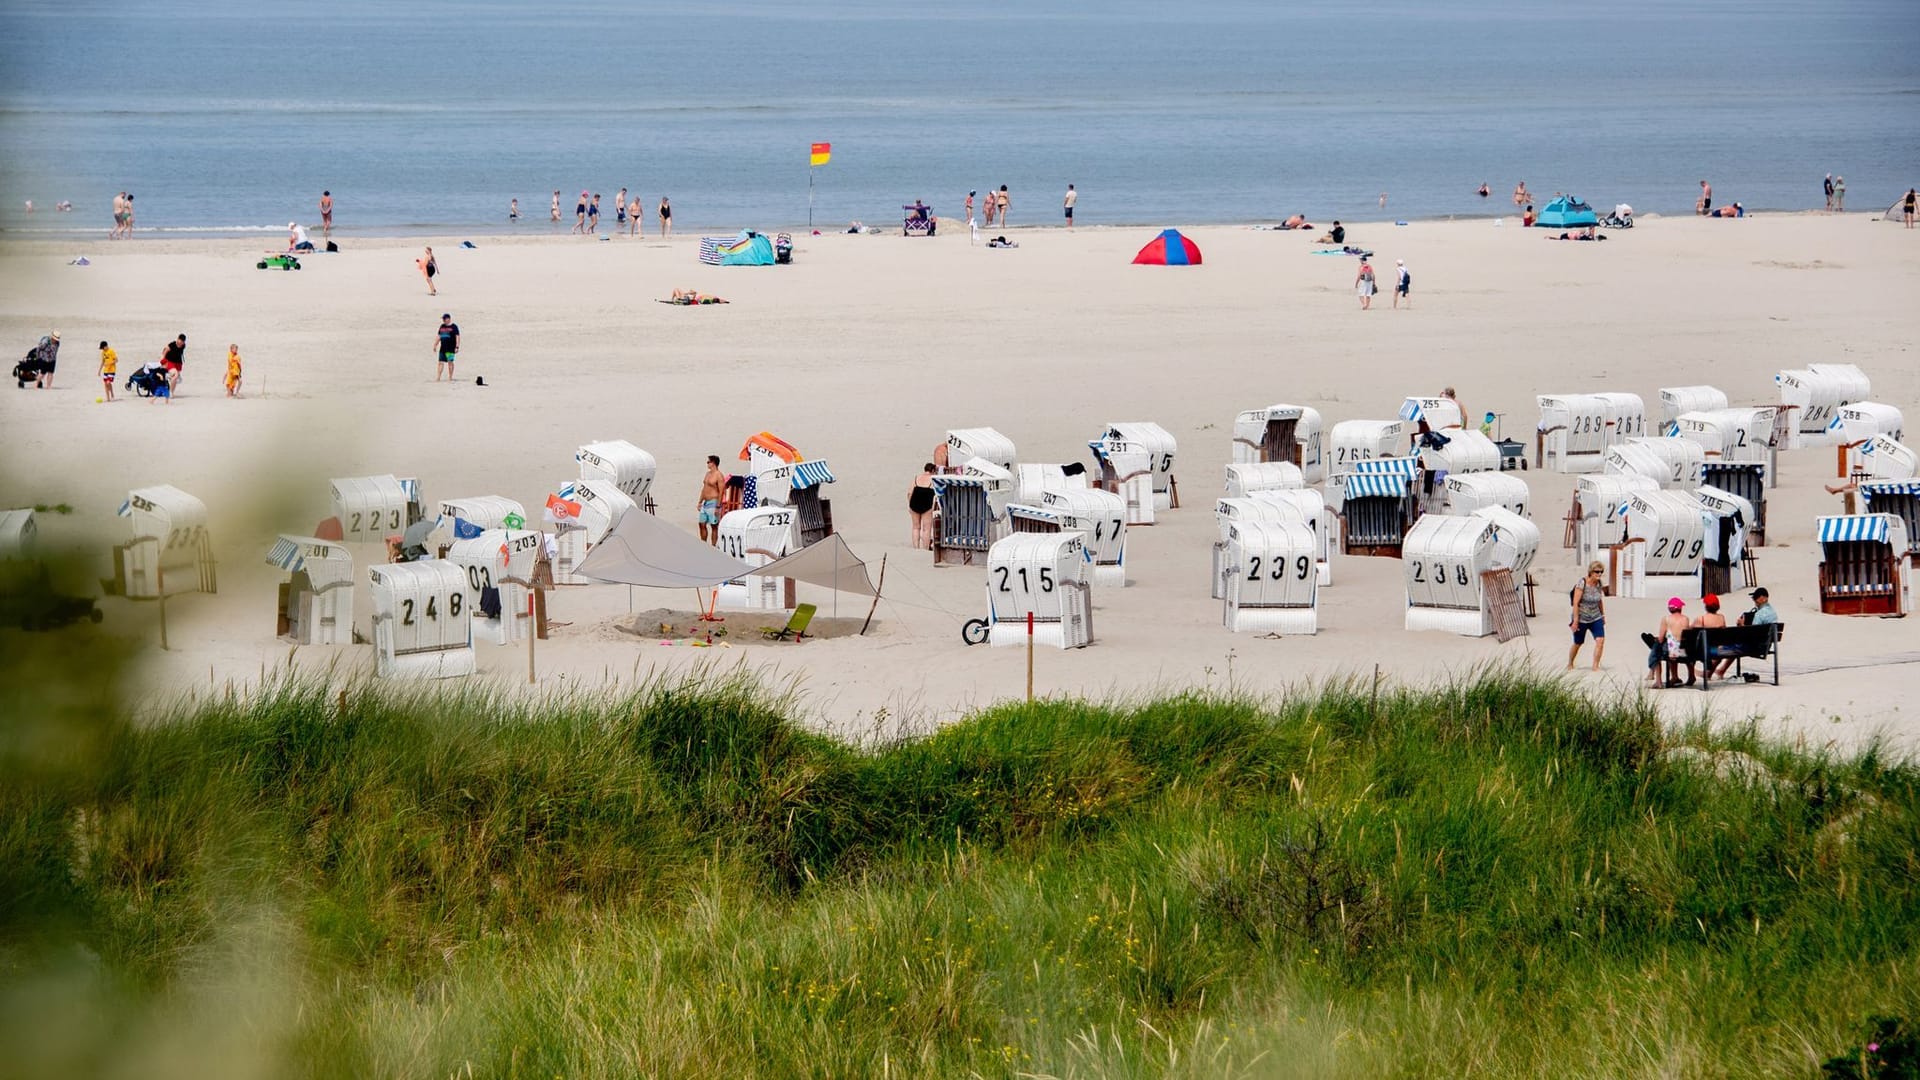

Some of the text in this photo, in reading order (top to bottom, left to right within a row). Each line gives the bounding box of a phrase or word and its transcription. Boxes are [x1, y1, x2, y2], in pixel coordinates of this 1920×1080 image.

[1422, 399, 1440, 409] 255
[1573, 415, 1602, 434] 289
[946, 434, 962, 449] 213
[1110, 441, 1128, 453] 251
[1876, 438, 1897, 456] 283
[774, 467, 790, 479] 221
[577, 484, 597, 502] 207
[1449, 480, 1463, 492] 212
[1631, 496, 1647, 514] 209
[1701, 494, 1723, 510] 205
[350, 509, 400, 532] 223
[768, 513, 790, 526] 232
[515, 535, 537, 553] 203
[1653, 537, 1703, 560] 209
[1247, 555, 1310, 581] 239
[1412, 560, 1468, 586] 238
[994, 565, 1054, 594] 215
[402, 592, 463, 626] 248
